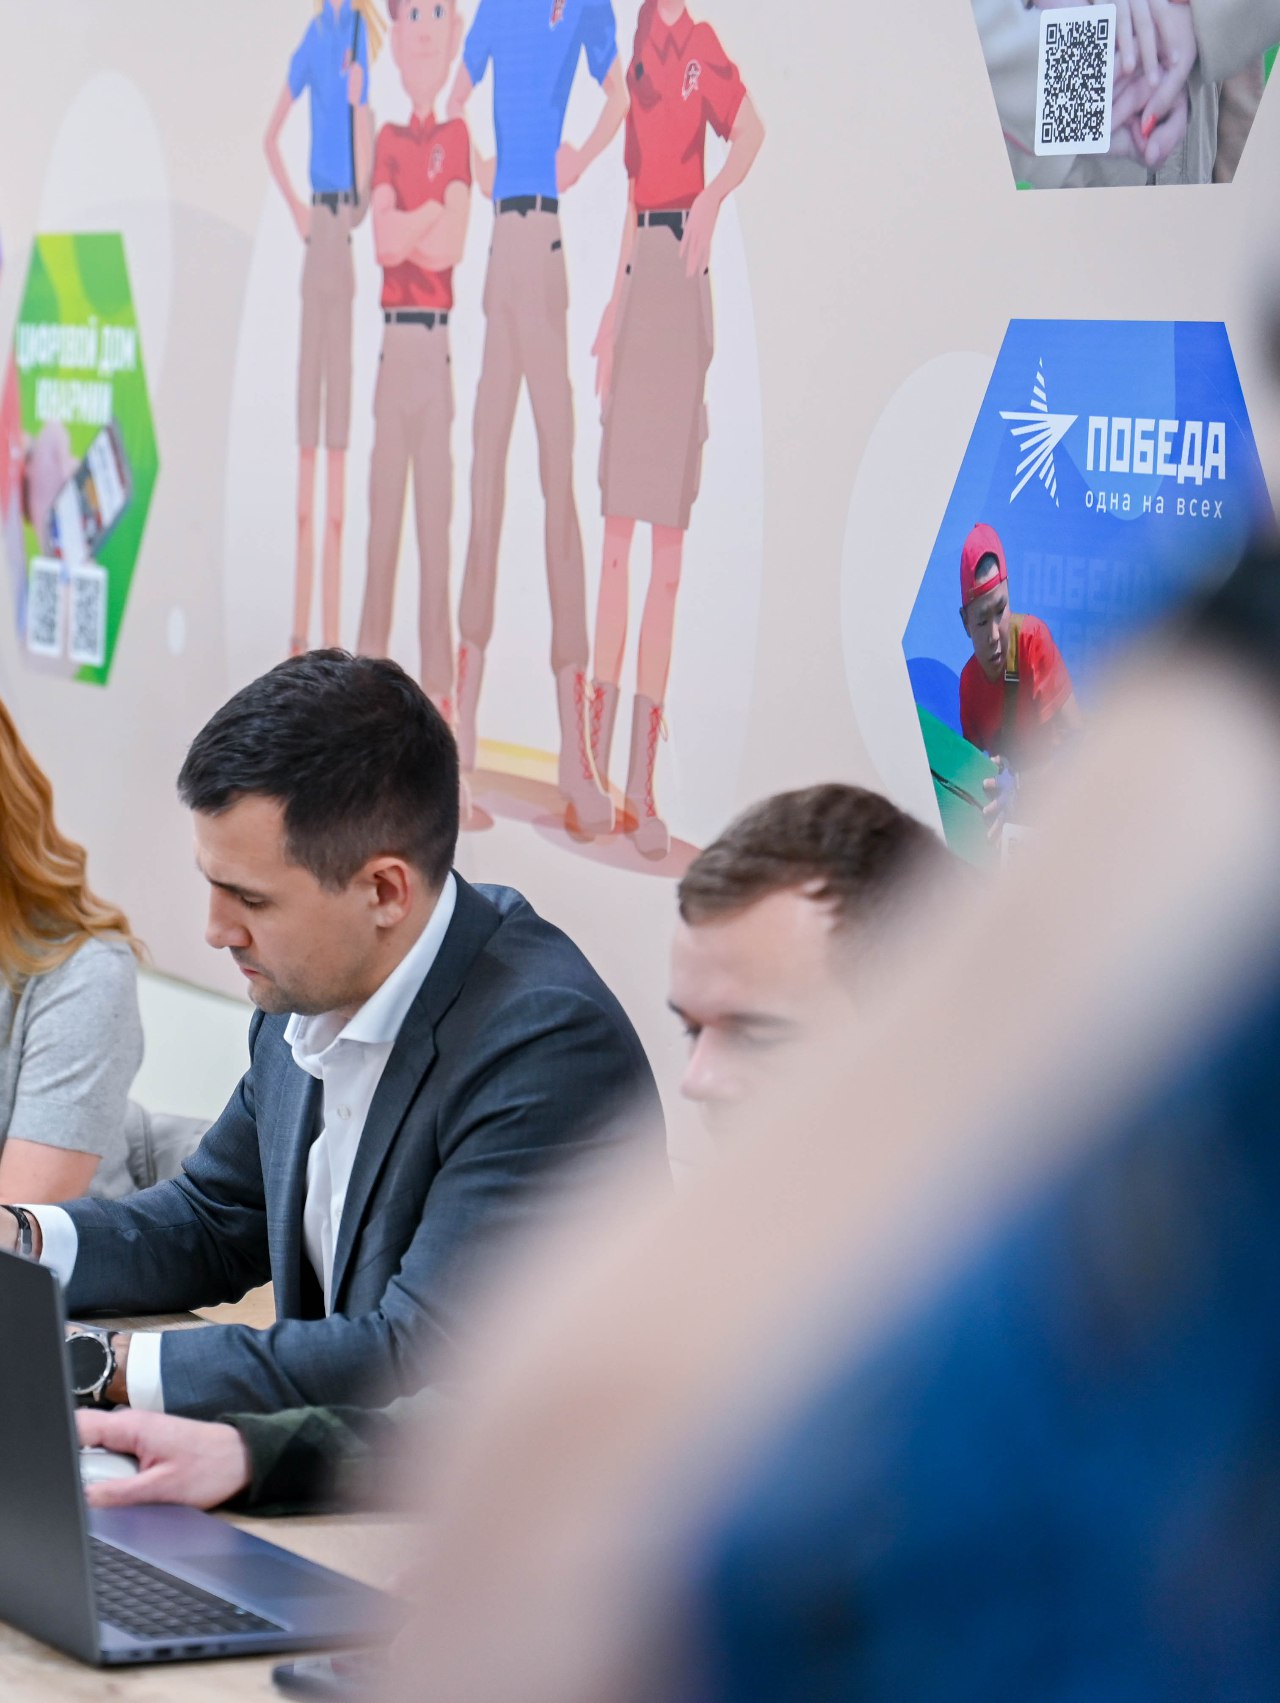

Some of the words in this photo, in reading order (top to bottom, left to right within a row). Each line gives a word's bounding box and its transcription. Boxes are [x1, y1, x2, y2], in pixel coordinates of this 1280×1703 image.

[1086, 415, 1226, 486] ПОБЕДА
[1085, 490, 1131, 513] одна
[1142, 494, 1165, 514] на
[1176, 498, 1223, 519] всех
